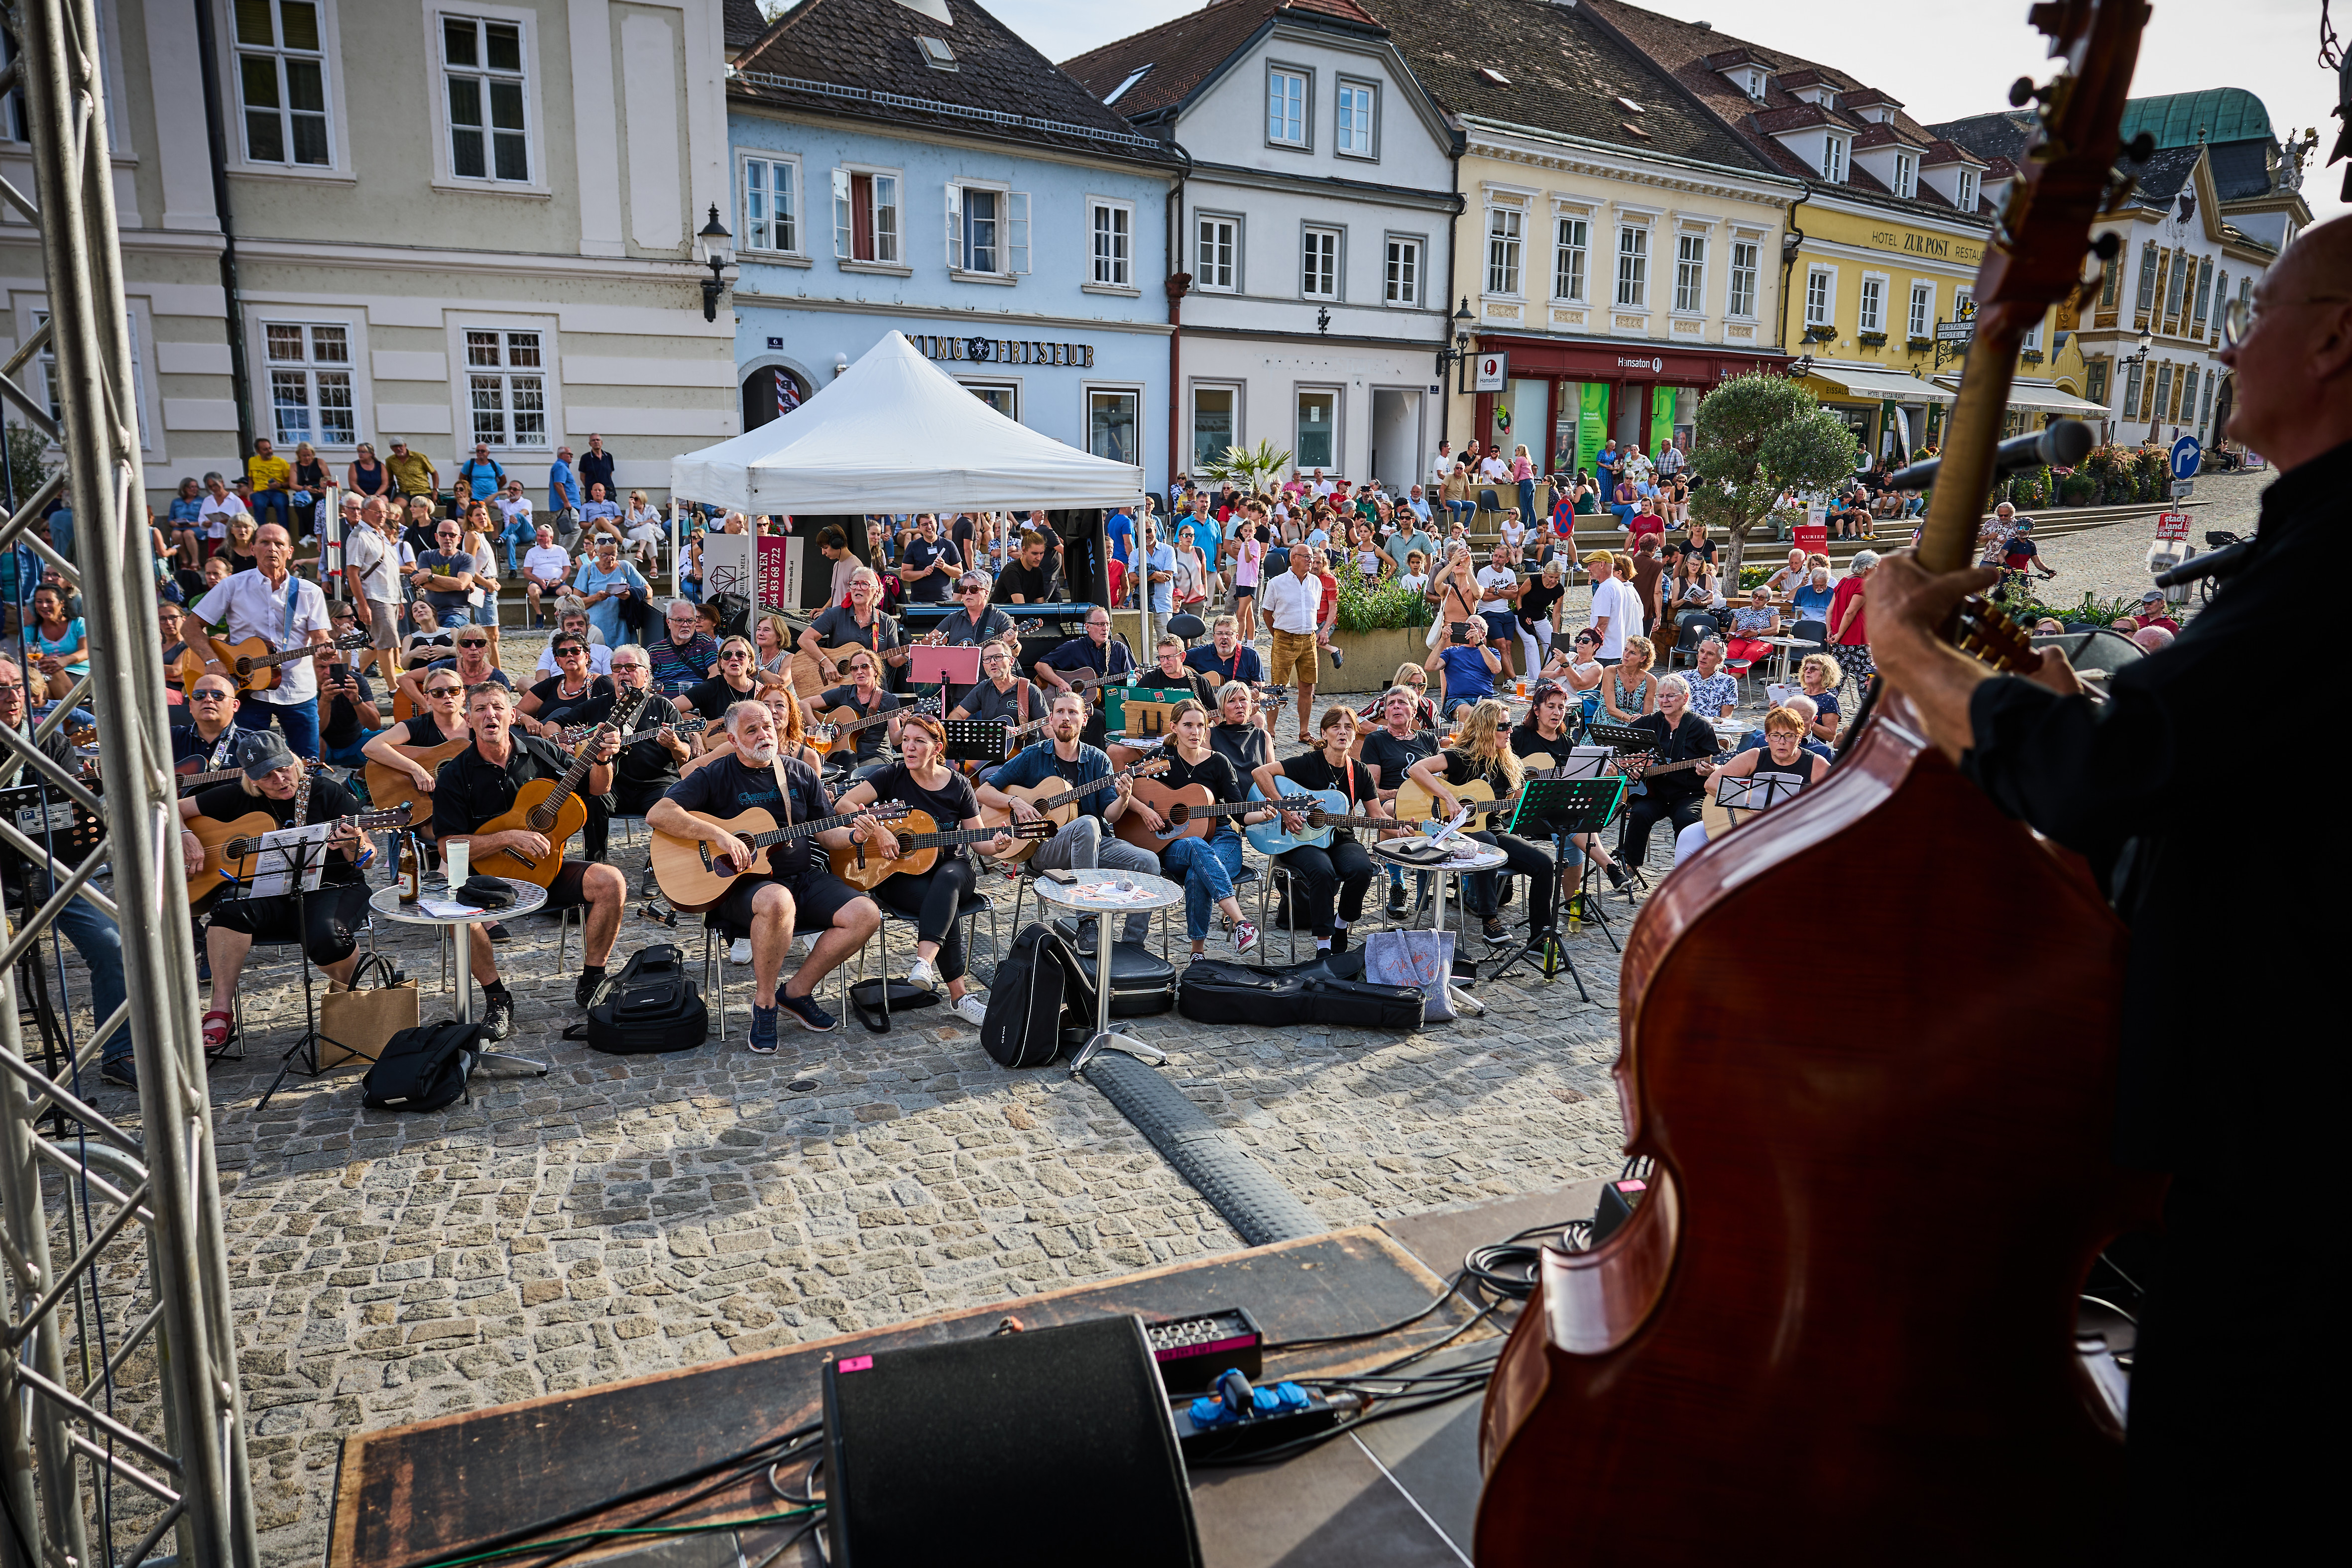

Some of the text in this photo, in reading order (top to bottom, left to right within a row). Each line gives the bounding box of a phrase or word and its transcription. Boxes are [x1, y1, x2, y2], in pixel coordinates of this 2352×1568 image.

[1872, 231, 1897, 246] HOTEL
[1904, 233, 1923, 252] ZUR
[1925, 237, 1950, 256] POST
[997, 339, 1095, 366] FRISEUR
[2158, 530, 2188, 539] zeitung
[1556, 541, 1566, 550] Ende
[771, 548, 780, 564] 722
[758, 552, 768, 593] MIETEN
[771, 566, 780, 577] 68
[770, 580, 779, 591] 83
[1492, 578, 1504, 587] Jack
